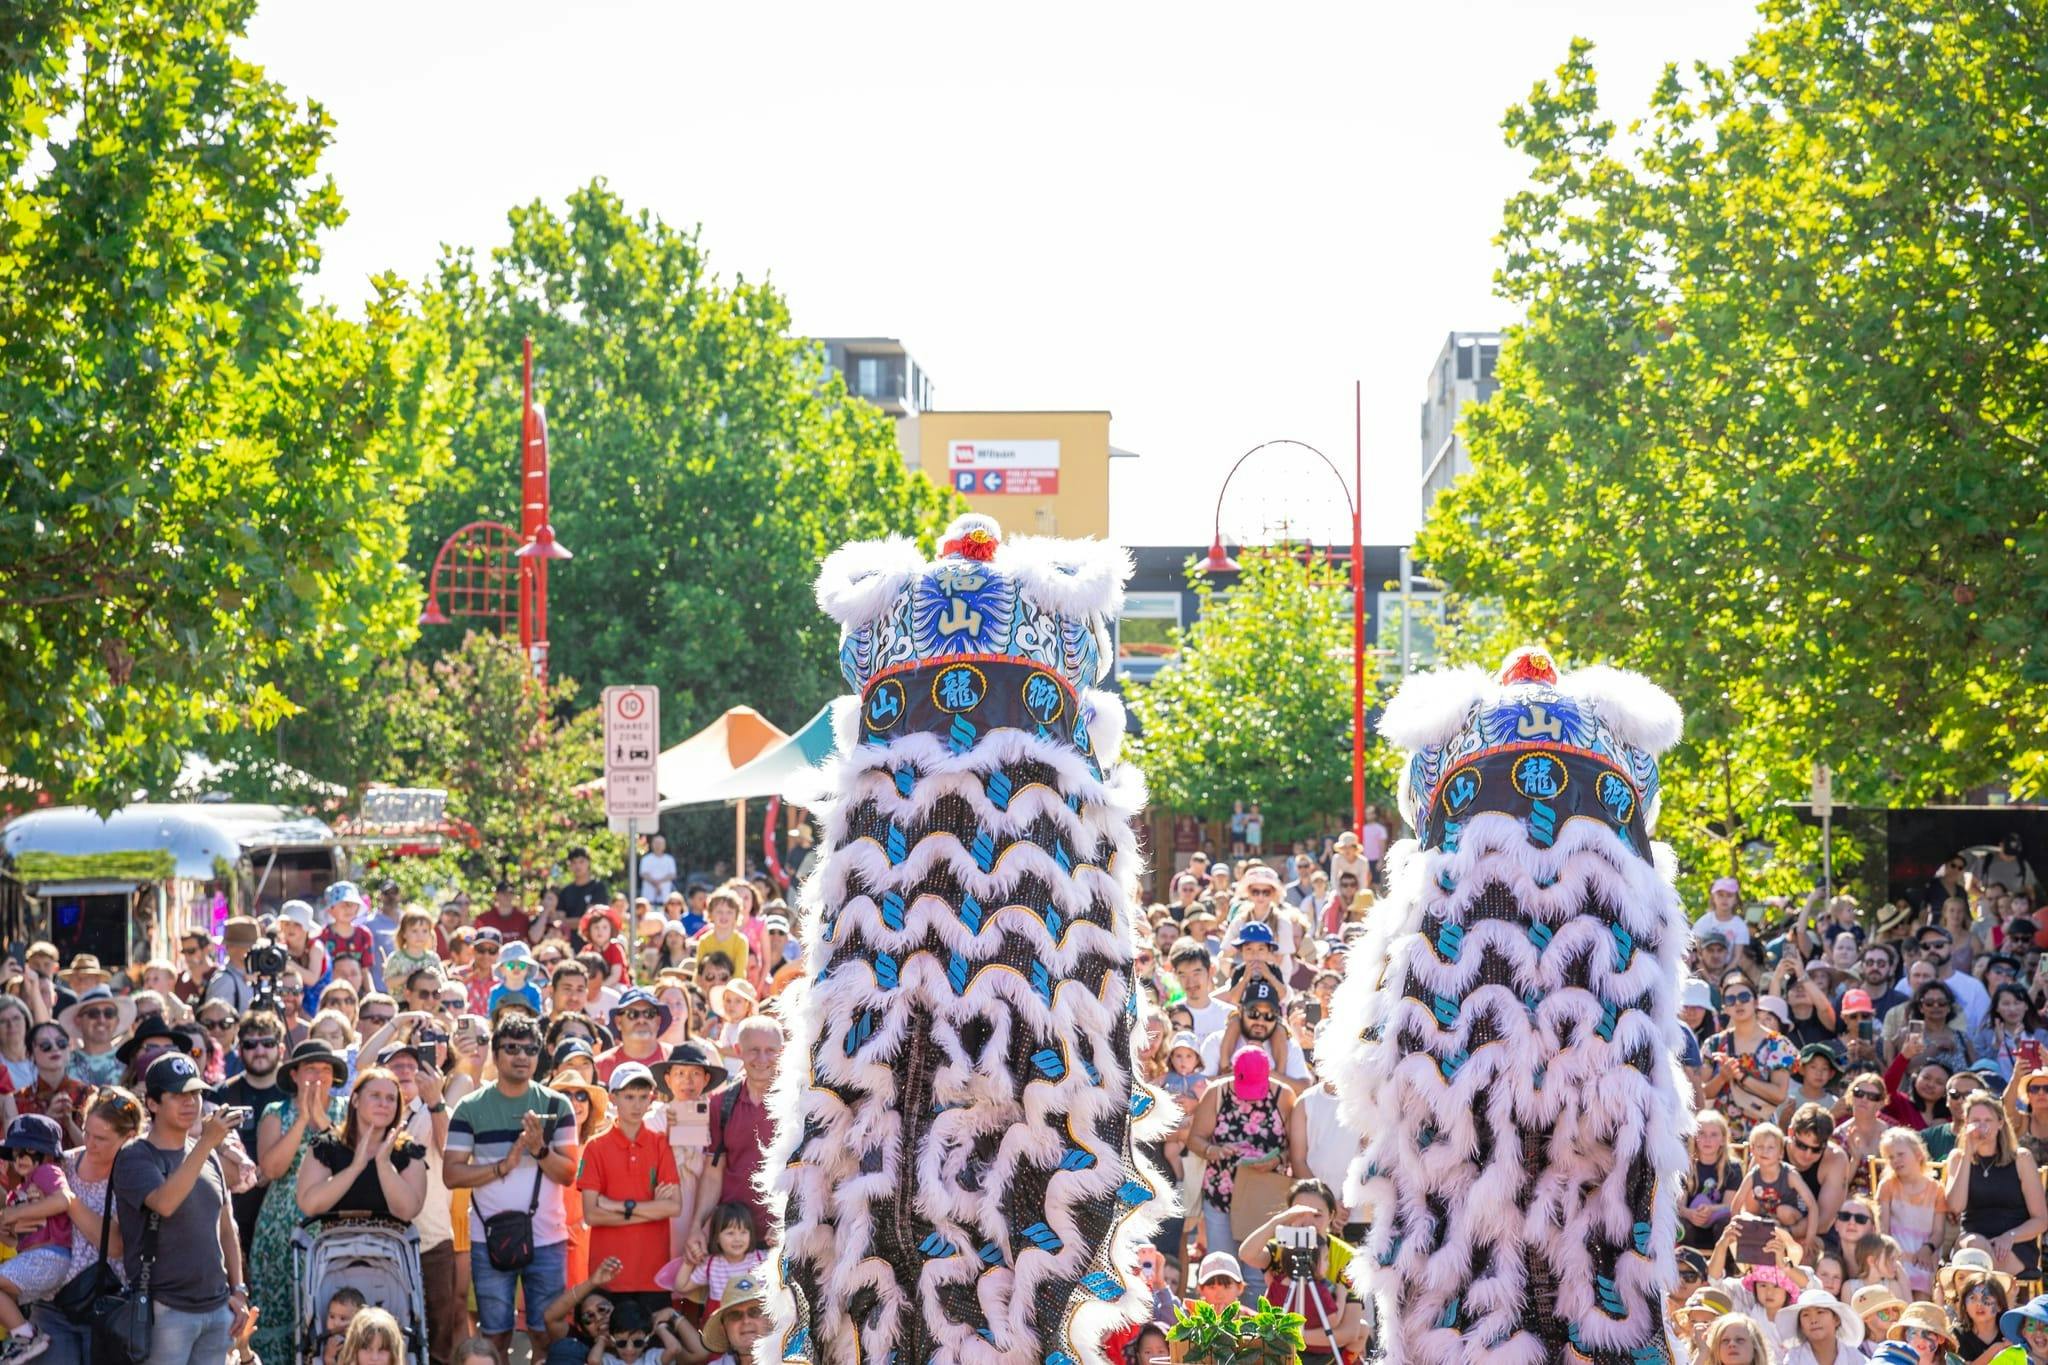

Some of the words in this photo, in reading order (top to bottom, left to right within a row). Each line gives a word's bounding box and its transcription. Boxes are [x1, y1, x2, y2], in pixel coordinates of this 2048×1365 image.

[959, 473, 974, 490] P
[624, 700, 638, 712] 10
[613, 722, 650, 731] SHARED
[619, 733, 643, 741] ZONE
[612, 775, 629, 784] GIVE
[635, 775, 651, 783] WAY
[627, 787, 637, 797] TO
[1258, 984, 1270, 998] B
